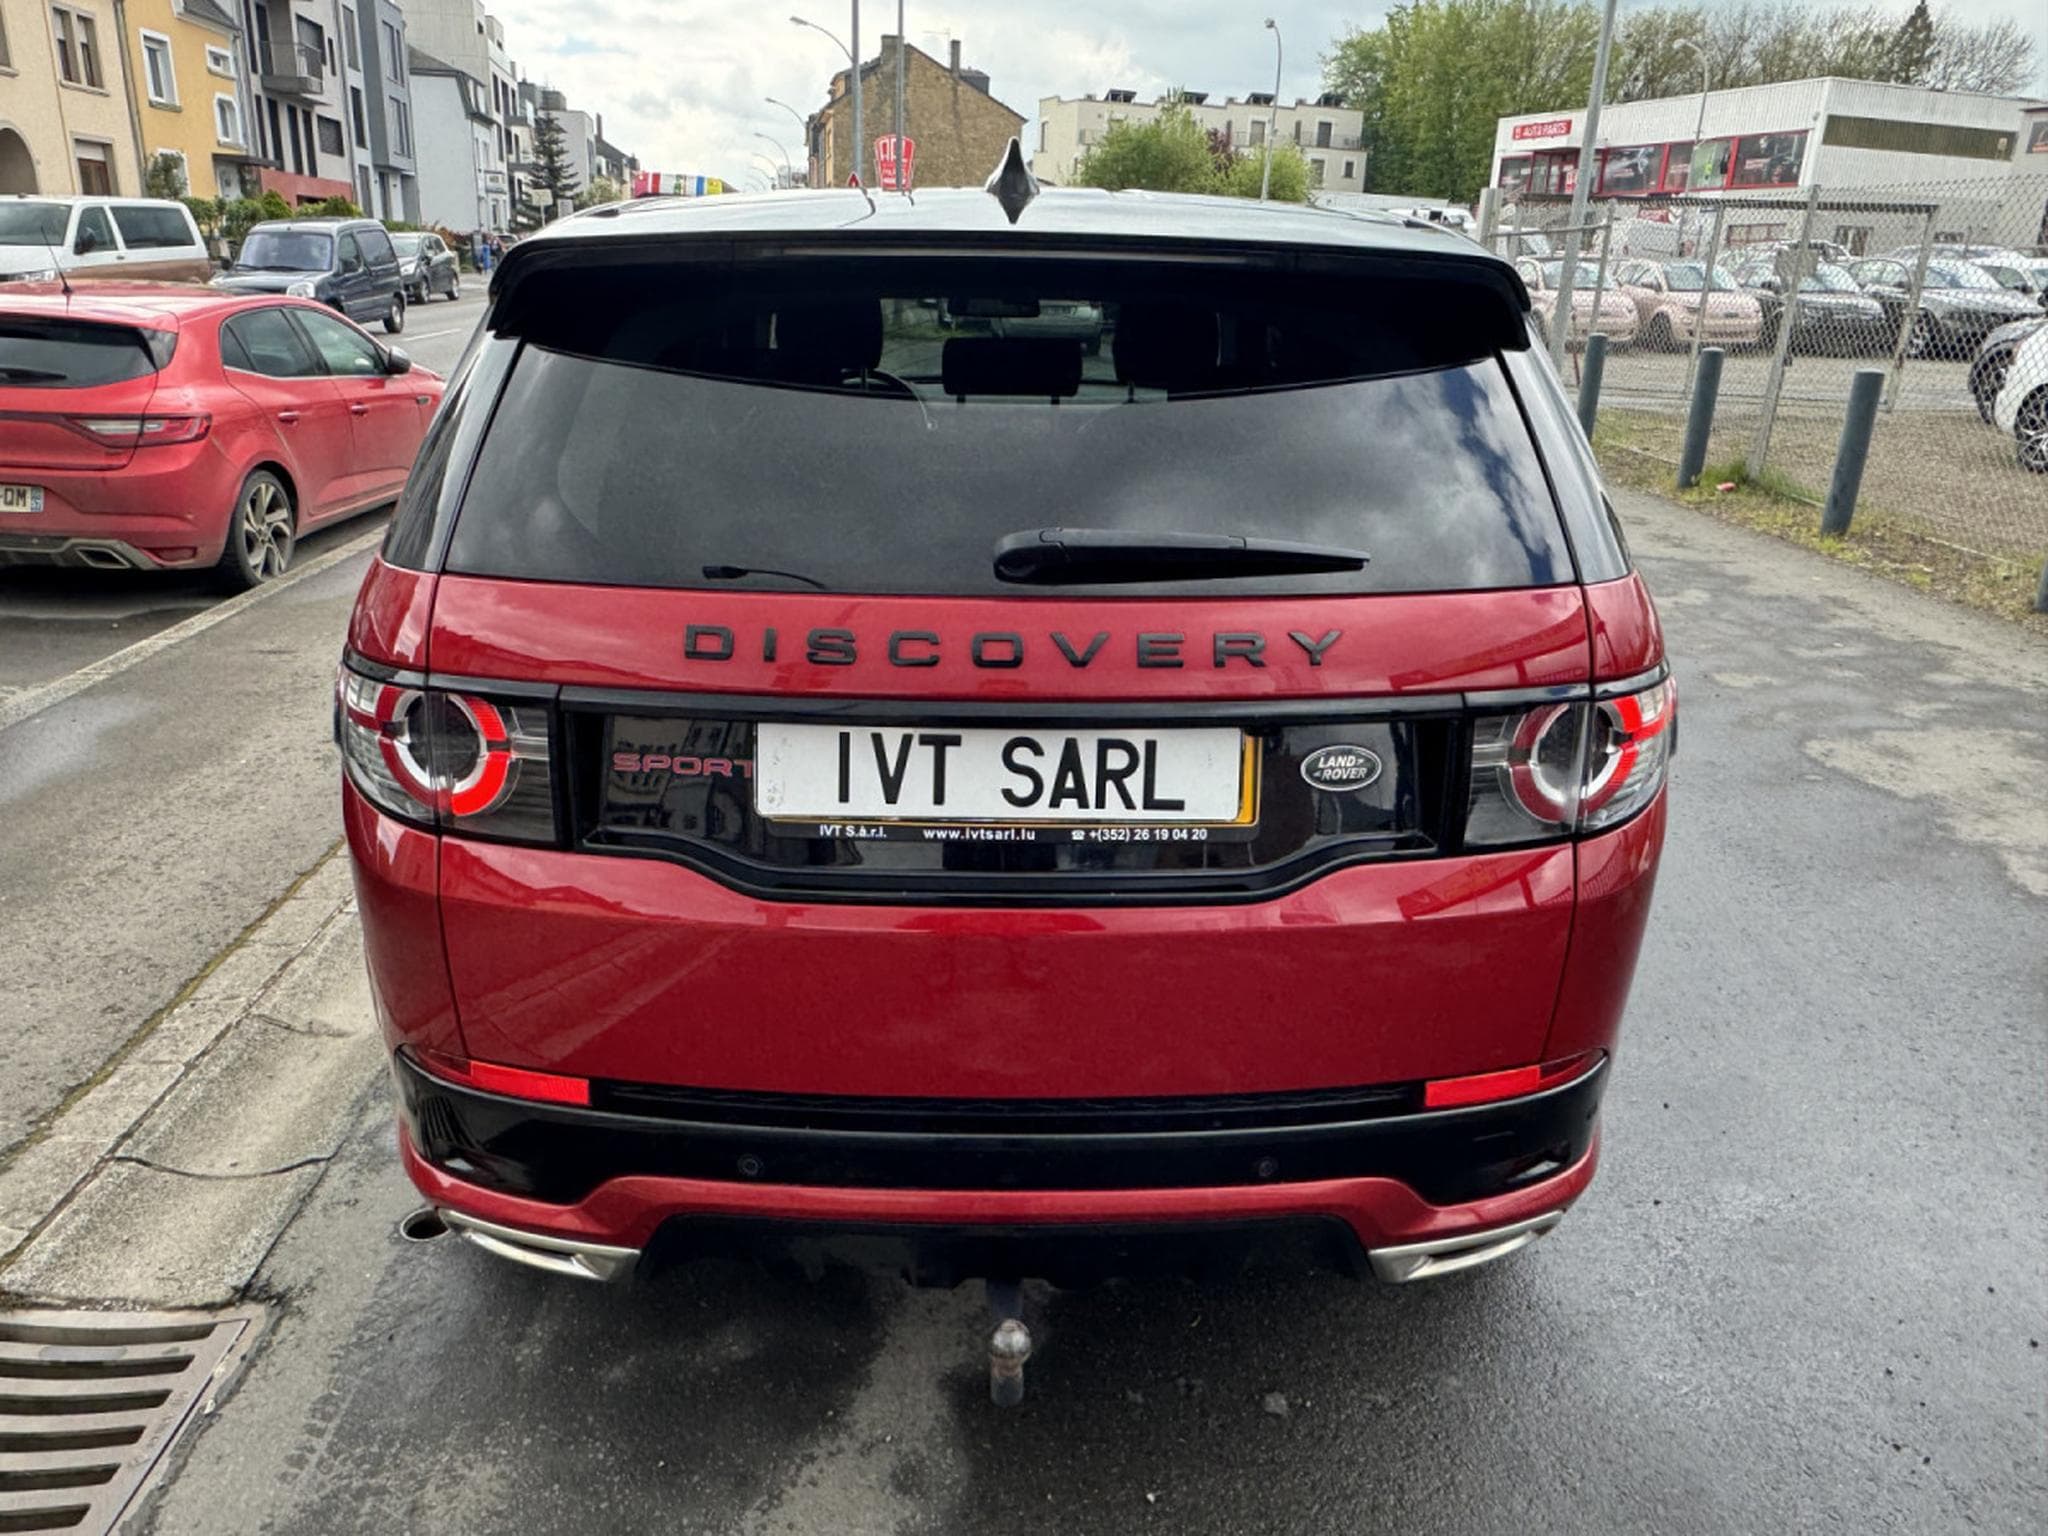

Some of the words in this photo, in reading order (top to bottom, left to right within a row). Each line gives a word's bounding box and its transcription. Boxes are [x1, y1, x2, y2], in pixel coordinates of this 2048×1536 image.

[684, 625, 1344, 669] DISCOVERY
[612, 752, 753, 778] SPORT
[1318, 755, 1356, 768] LAND
[1000, 735, 1186, 812] SARL
[1322, 767, 1368, 780] ROVER
[819, 824, 842, 837] IVT
[923, 828, 1036, 841] www.ivtsarl.lu
[1089, 828, 1130, 842] +(352)
[1134, 829, 1150, 841] 26
[1154, 829, 1169, 841] 19
[1172, 829, 1188, 841] 04
[1191, 829, 1208, 841] 20
